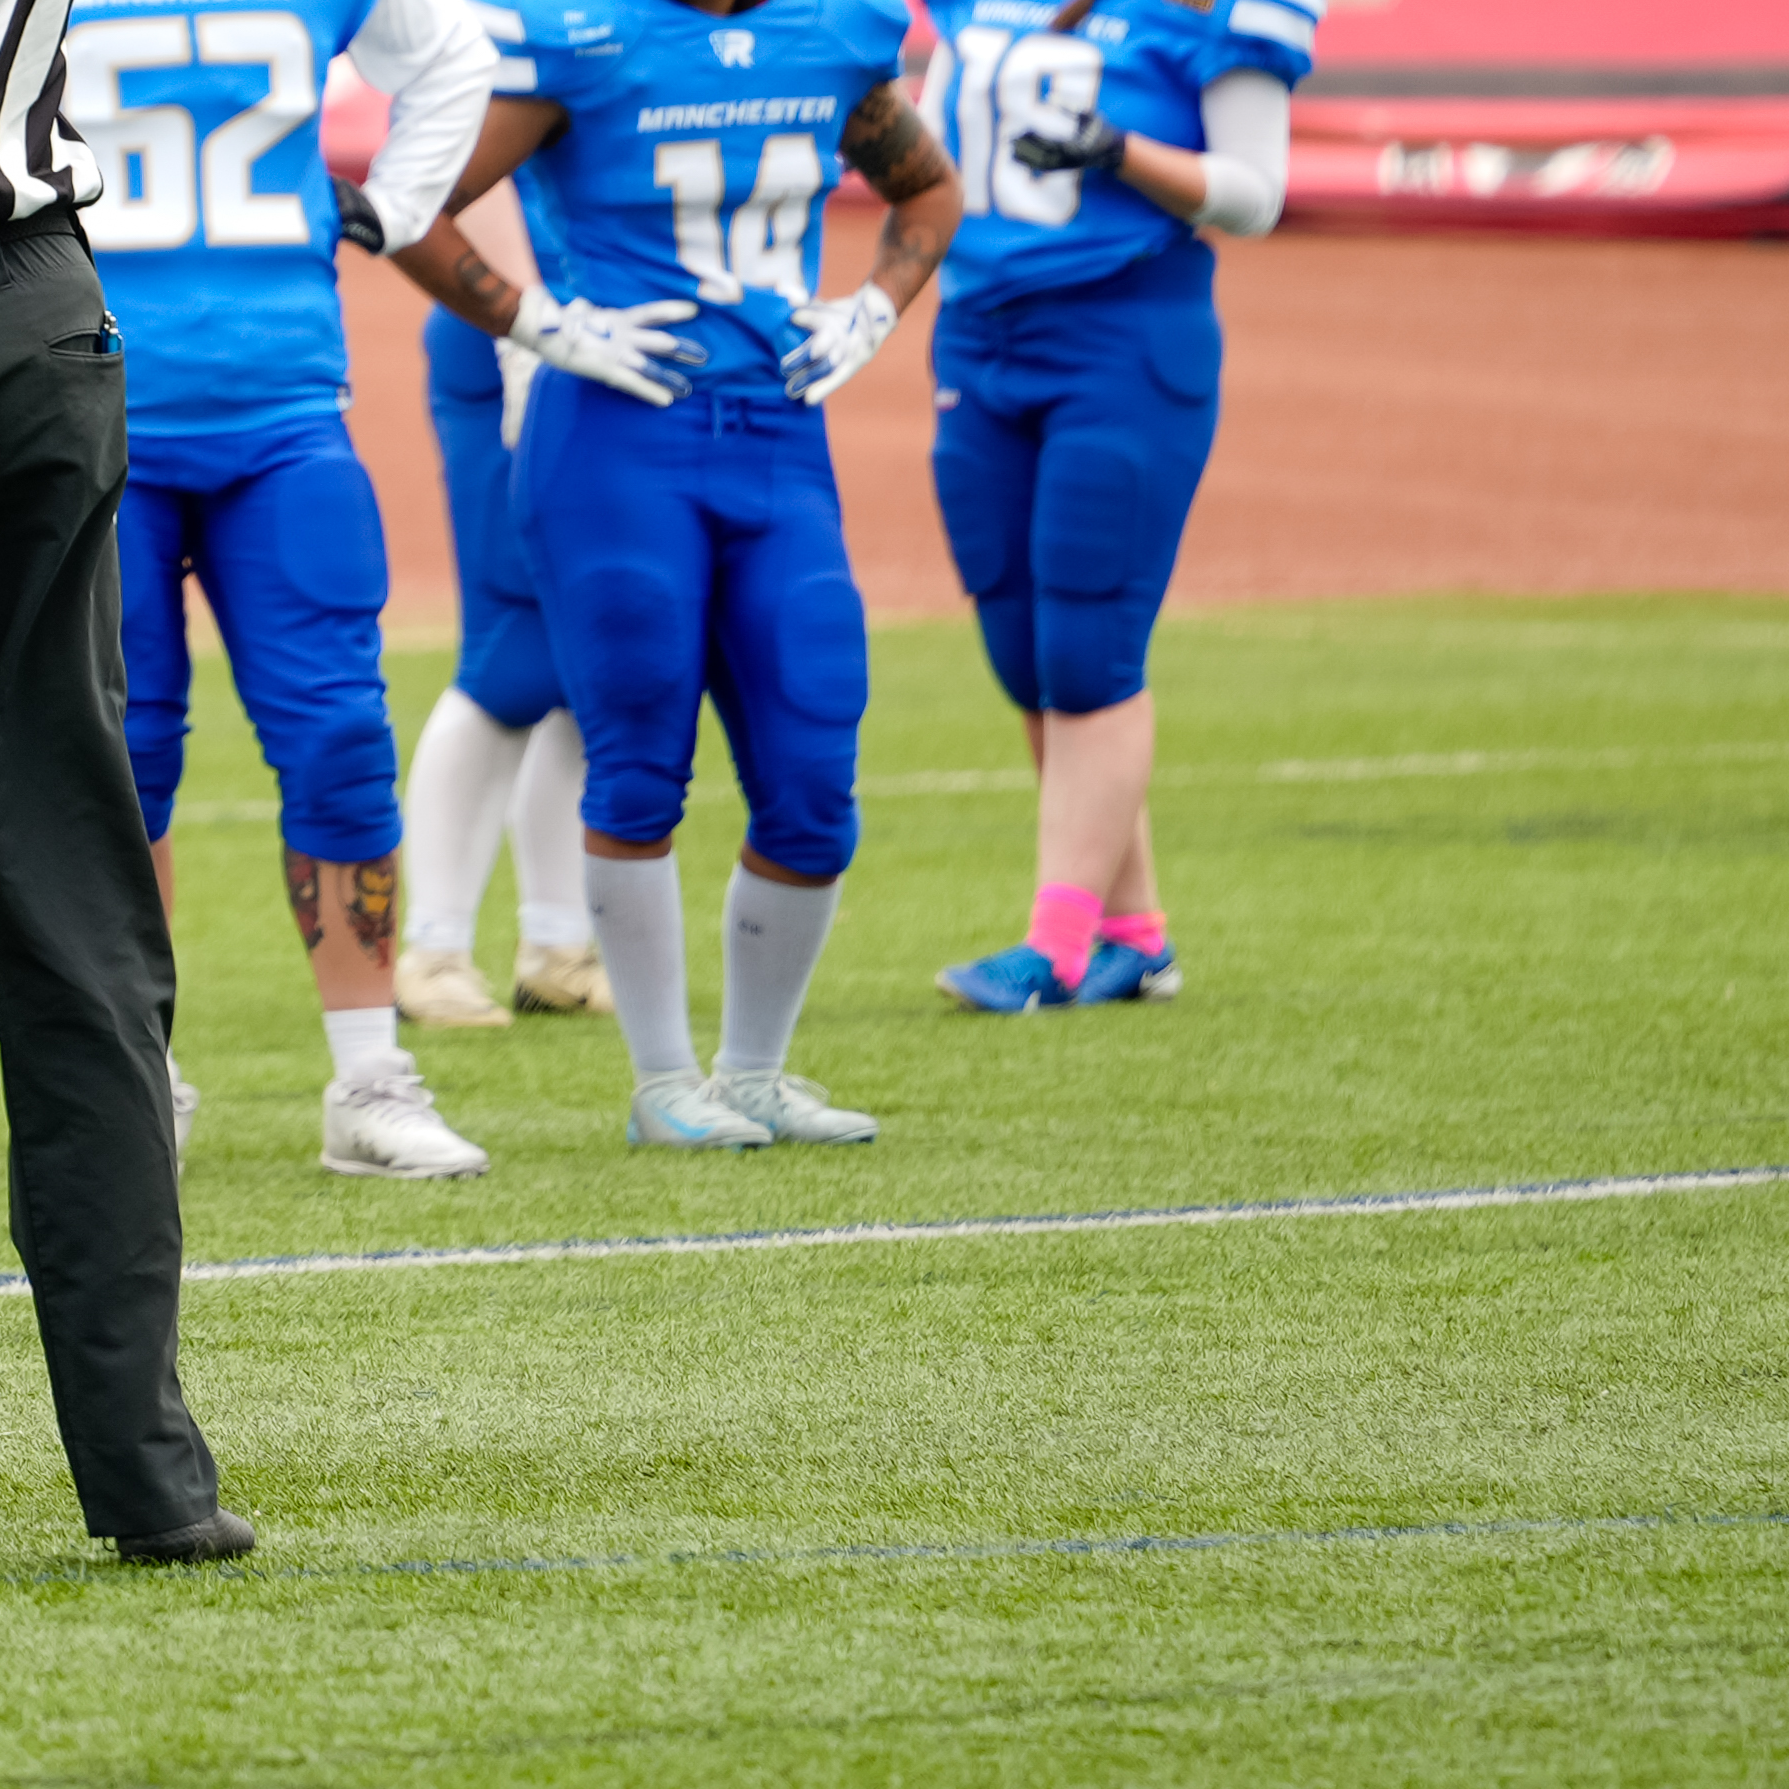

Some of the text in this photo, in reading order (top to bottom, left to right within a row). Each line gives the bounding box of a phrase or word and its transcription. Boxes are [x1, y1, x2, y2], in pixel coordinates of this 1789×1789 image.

[64, 10, 317, 252] 62
[636, 95, 839, 134] MANCHESTER
[956, 23, 1104, 229] 18
[652, 131, 824, 309] 14
